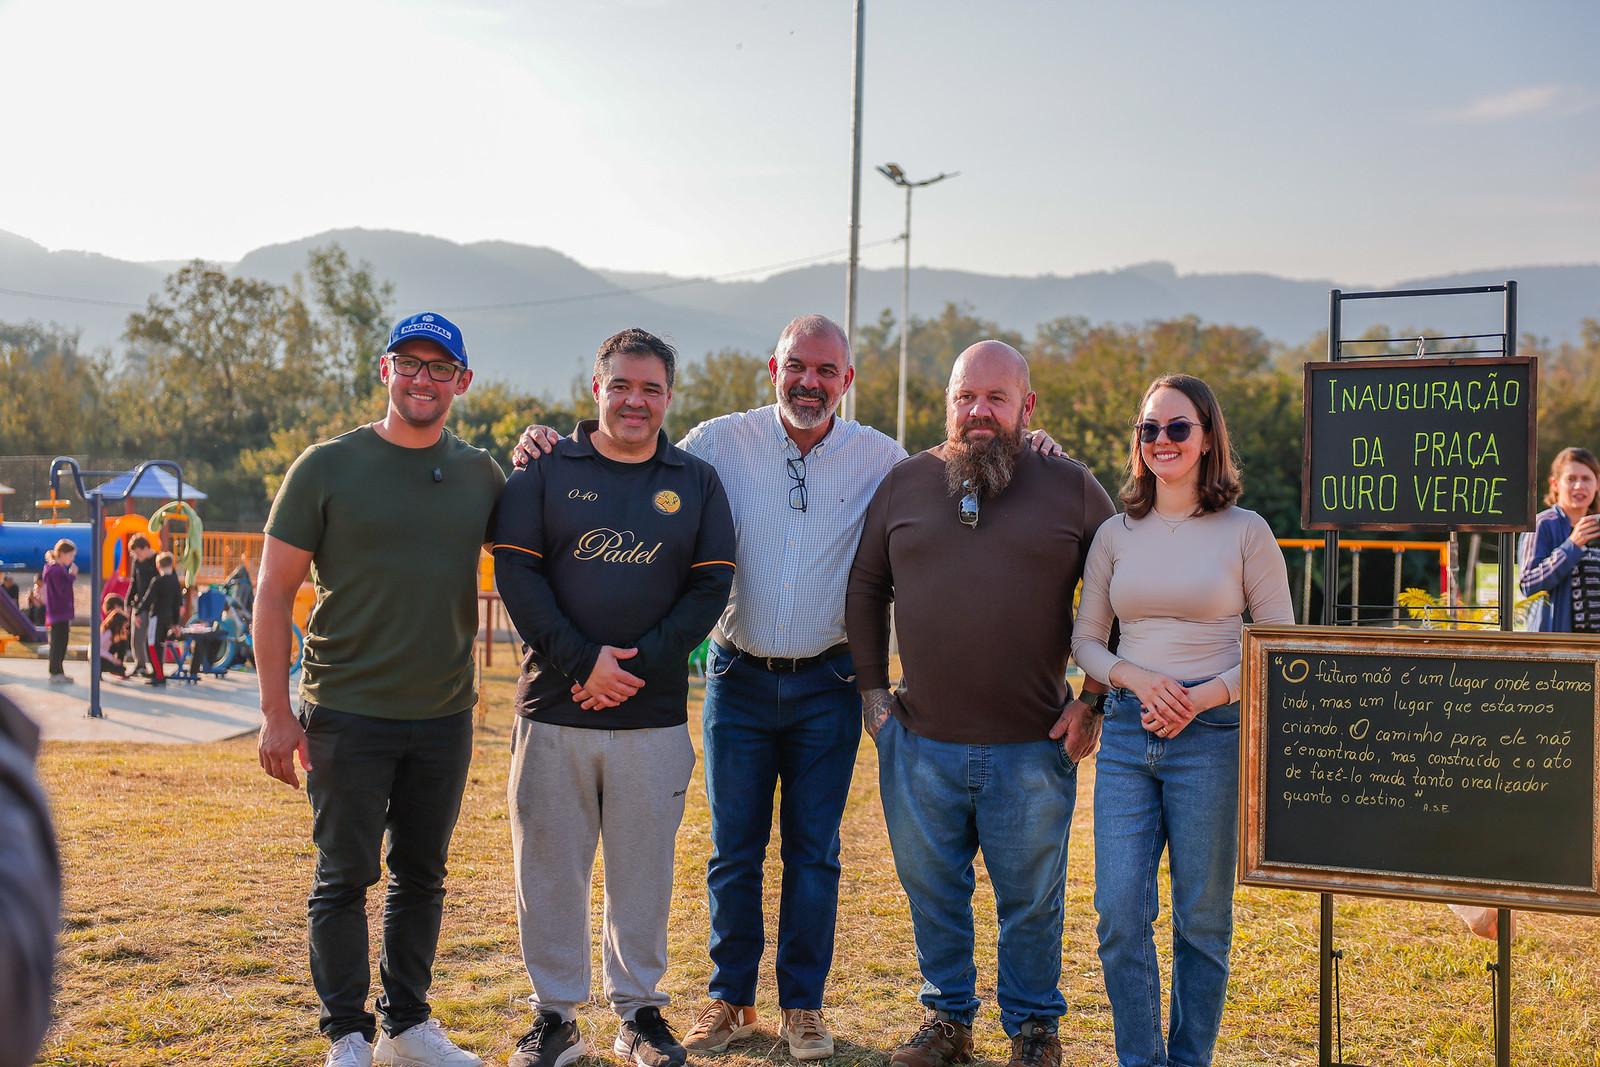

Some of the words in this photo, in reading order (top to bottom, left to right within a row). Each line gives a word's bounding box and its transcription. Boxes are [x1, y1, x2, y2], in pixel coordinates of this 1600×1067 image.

[403, 323, 451, 338] NACIONAL
[1328, 372, 1520, 414] INAUGURAÇÃO
[1352, 436, 1385, 468] DA
[1414, 431, 1500, 469] PRAÇA
[1322, 474, 1397, 512] OURO
[1414, 475, 1508, 514] VERDE
[573, 527, 663, 565] Padel
[1314, 660, 1358, 684] futuro
[1362, 666, 1392, 685] não
[1401, 666, 1417, 684] é
[1418, 674, 1444, 685] um
[1449, 662, 1489, 695] lugar
[1494, 671, 1531, 692] onde
[1535, 669, 1592, 692] estamos
[1282, 690, 1316, 711] indo,
[1319, 698, 1352, 709] mas
[1359, 695, 1384, 708] um
[1393, 690, 1434, 717] lugar
[1443, 700, 1472, 720] que
[1480, 694, 1555, 714] estamos
[1282, 716, 1344, 735] criando.
[1349, 718, 1371, 741] O
[1375, 721, 1443, 743] caminho
[1450, 732, 1488, 748] para
[1499, 727, 1527, 746] ele
[1536, 730, 1572, 746] não
[1391, 751, 1416, 763] mas
[1428, 748, 1501, 769] construído
[1543, 748, 1572, 769] ato
[1285, 762, 1302, 779] de
[1310, 762, 1362, 784] fazê-lo
[1369, 769, 1407, 787] muda
[1412, 766, 1454, 788] tanto
[1283, 786, 1332, 809] quanto
[1341, 793, 1350, 804] o
